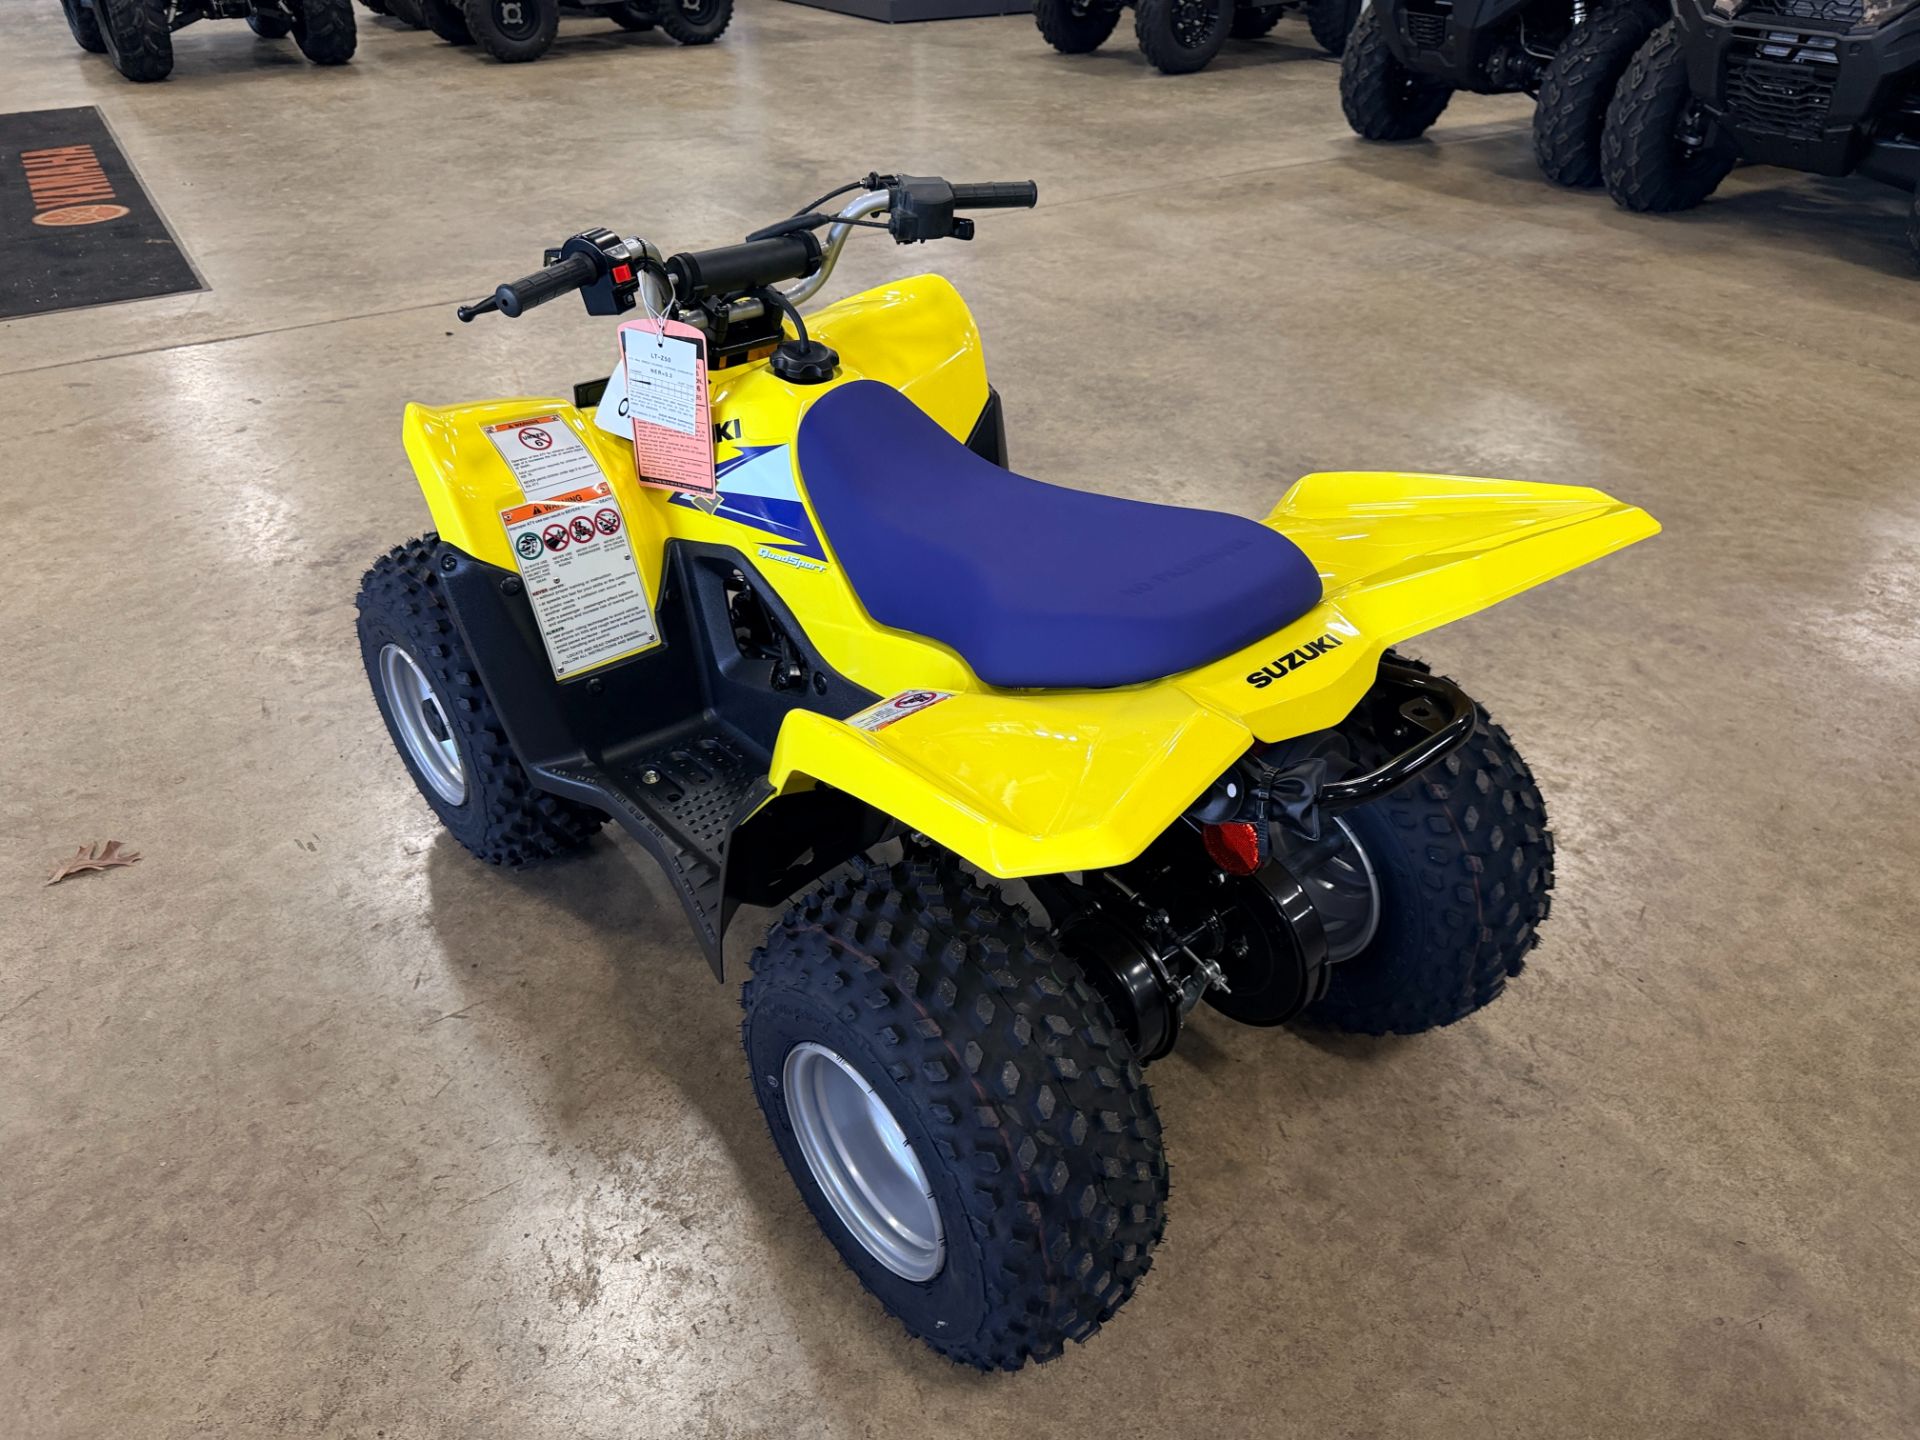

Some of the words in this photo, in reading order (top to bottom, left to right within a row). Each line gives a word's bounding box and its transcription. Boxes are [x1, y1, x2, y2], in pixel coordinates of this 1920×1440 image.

[20, 144, 117, 210] YAMAHA
[650, 352, 672, 363] LT-Z50
[535, 439, 544, 447] 6
[544, 494, 583, 511] WAING
[758, 548, 826, 572] QuadSport
[1246, 633, 1343, 689] SUZUKI
